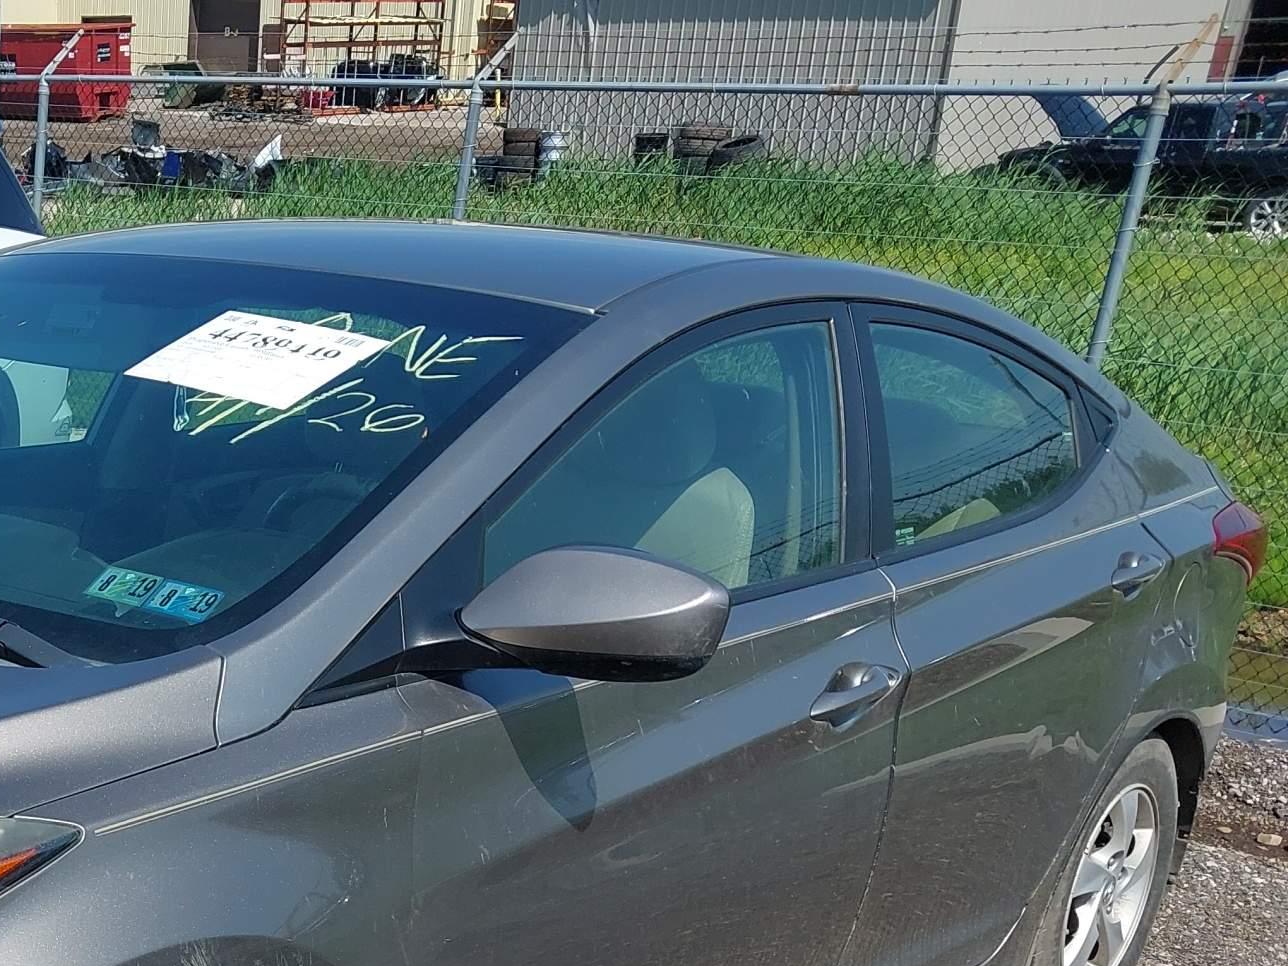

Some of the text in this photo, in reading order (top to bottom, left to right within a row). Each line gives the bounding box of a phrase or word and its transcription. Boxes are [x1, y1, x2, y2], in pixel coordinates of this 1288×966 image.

[99, 574, 158, 598] 8 19
[158, 589, 219, 614] 8 19
